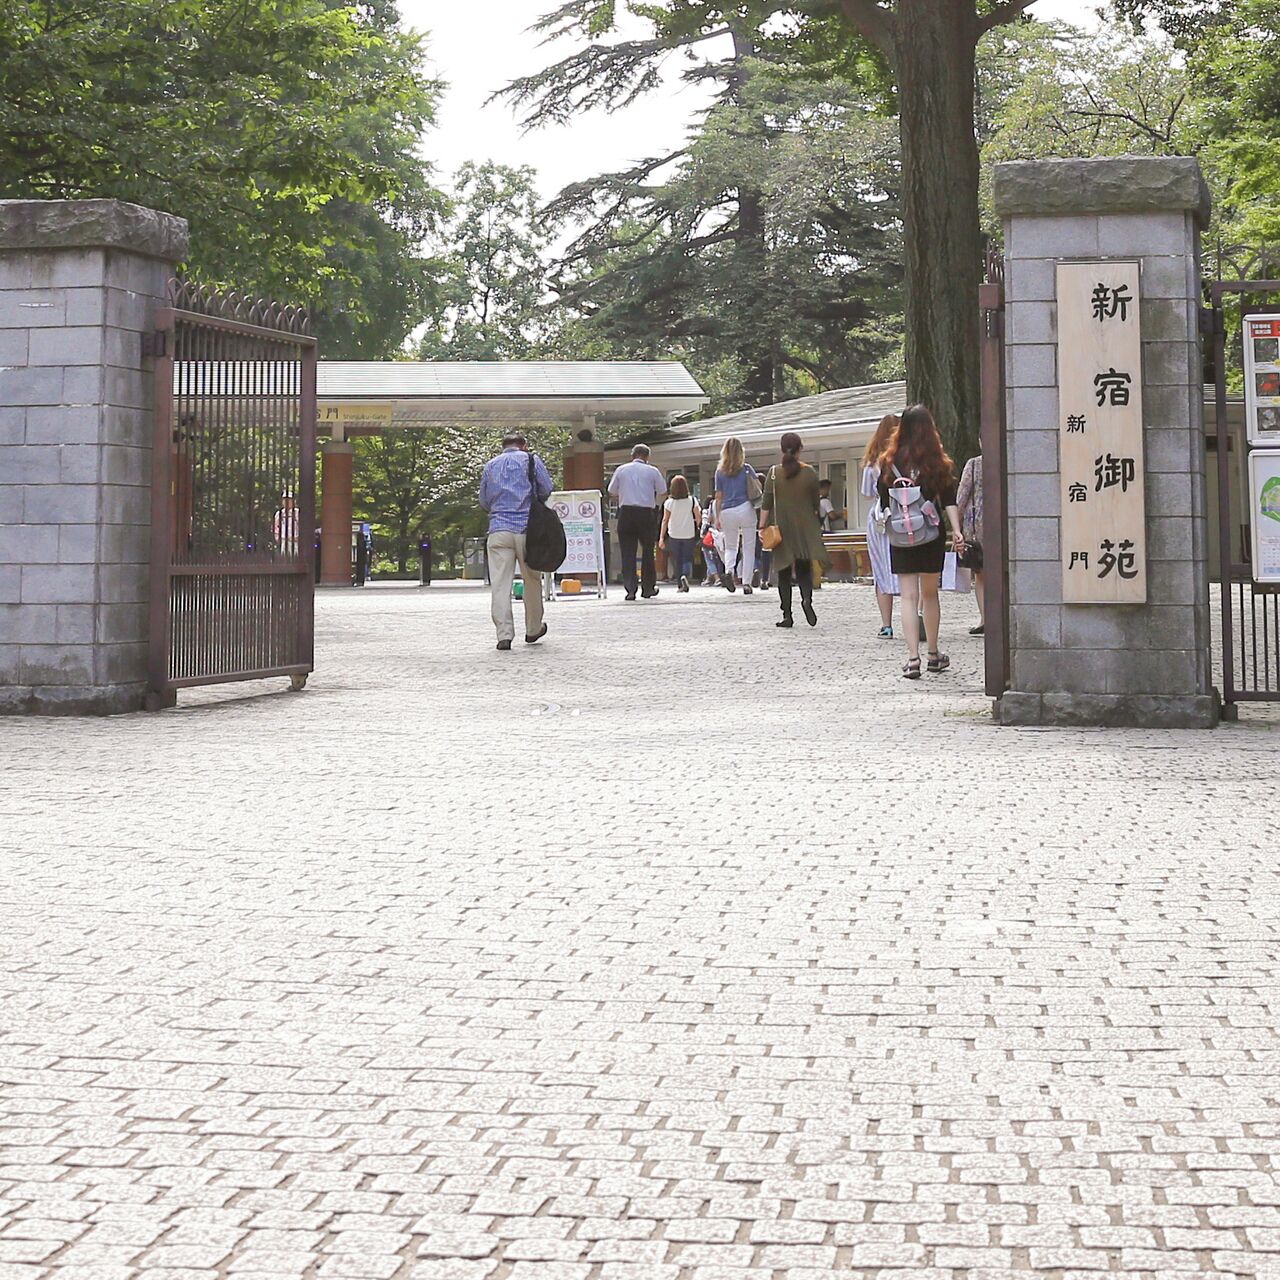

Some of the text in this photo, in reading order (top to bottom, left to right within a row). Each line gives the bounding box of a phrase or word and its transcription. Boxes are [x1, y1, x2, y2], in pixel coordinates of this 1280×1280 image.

[1066, 414, 1089, 571] 新宿門
[1091, 282, 1139, 580] 新宿御苑
